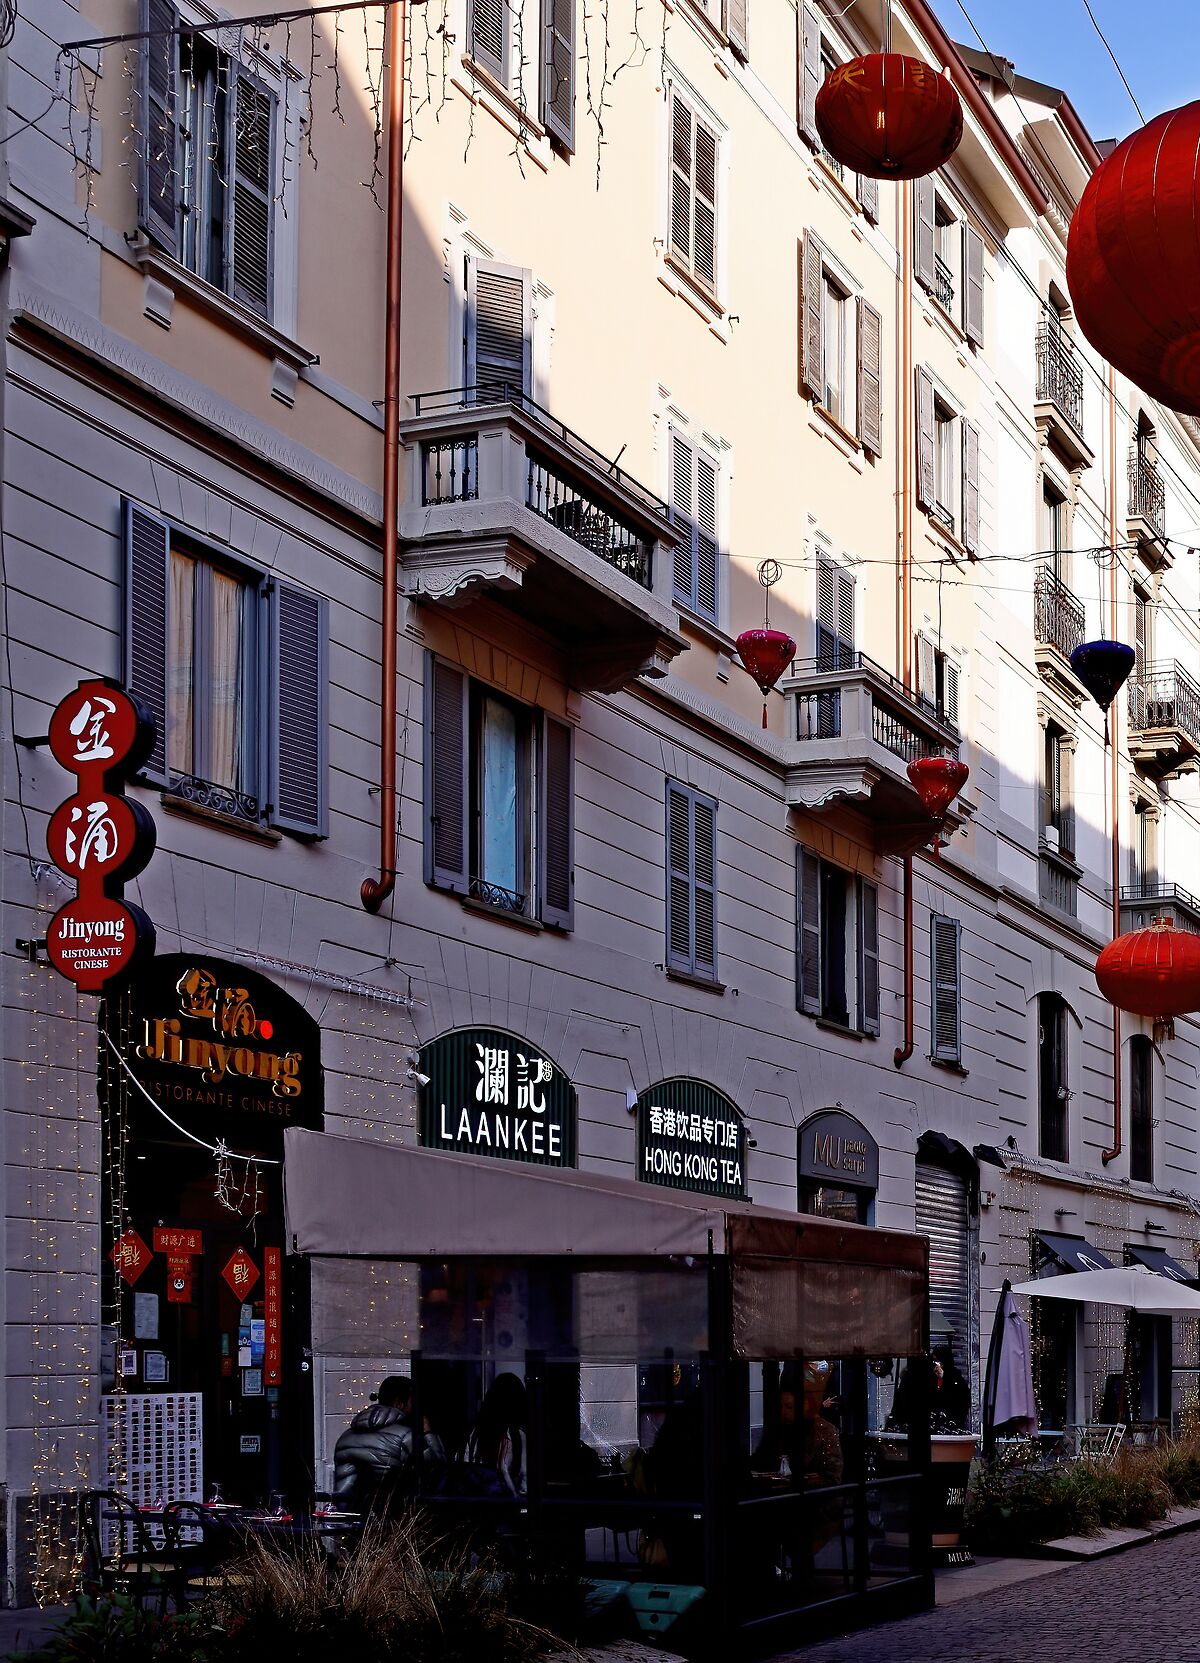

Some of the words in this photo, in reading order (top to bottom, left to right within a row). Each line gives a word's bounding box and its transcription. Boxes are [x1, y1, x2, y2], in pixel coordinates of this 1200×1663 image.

[58, 917, 125, 943] Jinyong
[61, 947, 122, 959] RISTORANTE
[74, 959, 109, 969] CINESE
[136, 1017, 303, 1098] Jinyong
[139, 1080, 234, 1109] RISTORANTE
[241, 1096, 292, 1118] CINESE
[441, 1103, 561, 1157] LAANKEE
[649, 1106, 738, 1149] 香港饮品专门店
[645, 1146, 682, 1176] HONG
[684, 1153, 718, 1182] KONG
[720, 1159, 742, 1186] TEA
[813, 1132, 841, 1169] MU
[232, 1263, 250, 1285] 福
